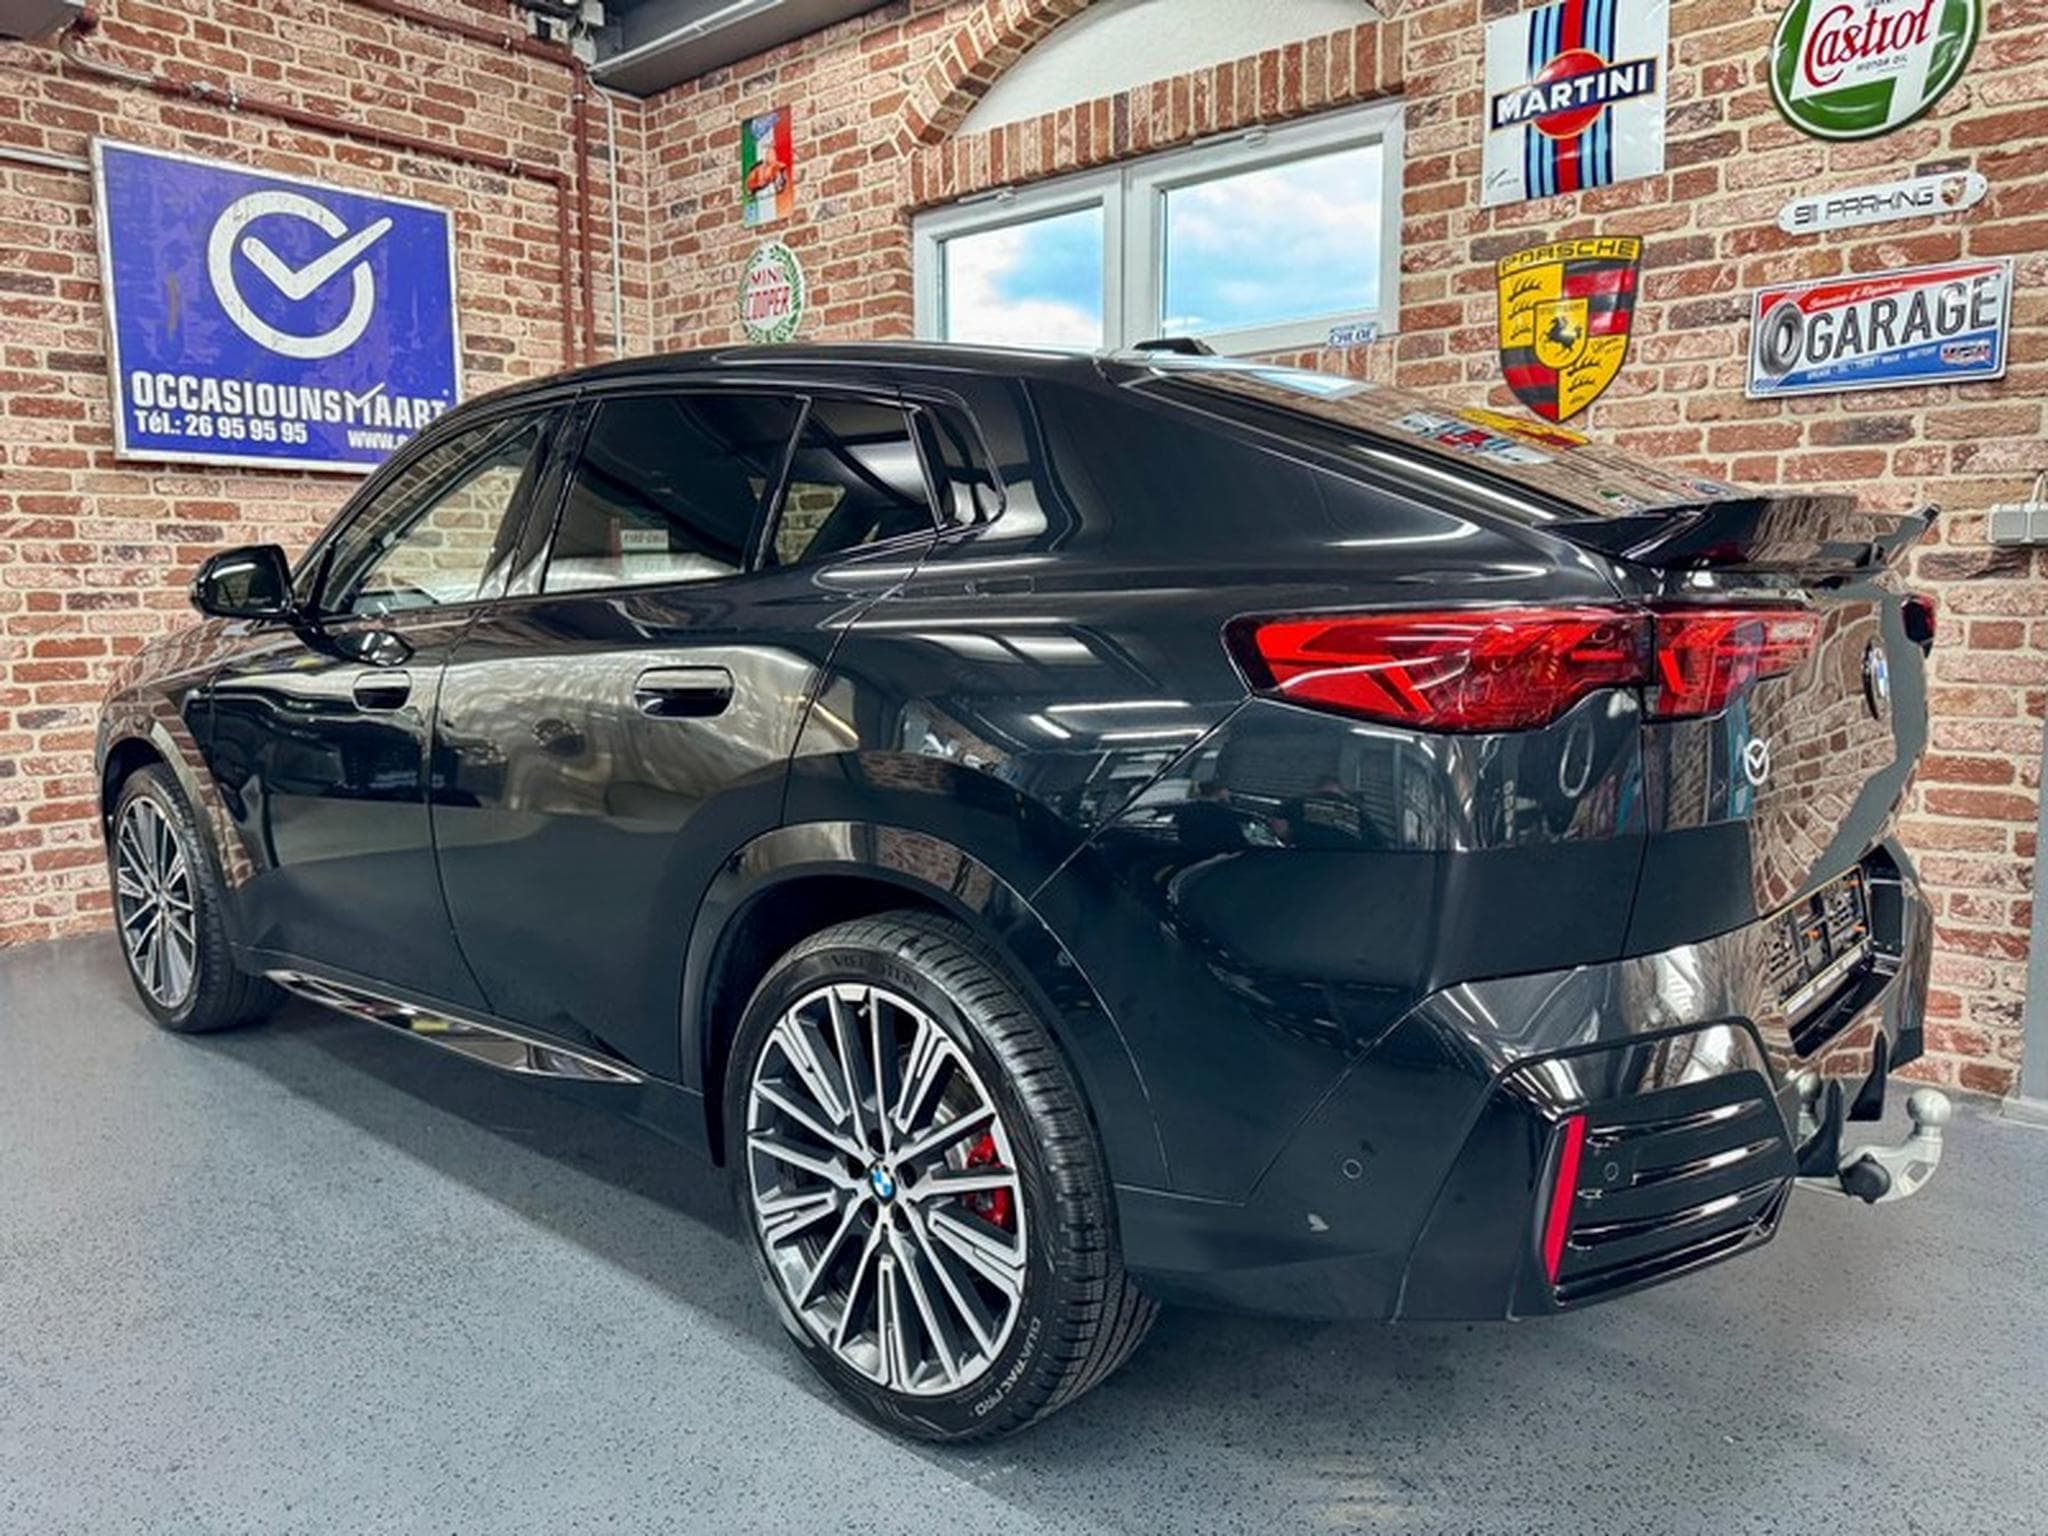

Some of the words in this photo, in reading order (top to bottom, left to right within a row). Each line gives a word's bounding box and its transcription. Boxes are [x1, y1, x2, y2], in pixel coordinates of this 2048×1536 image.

[1804, 0, 1936, 87] Castrol
[1497, 63, 1648, 123] MARTINI
[1825, 185, 1935, 220] PARKING
[1502, 240, 1635, 272] PORSCHE
[1805, 275, 2000, 365] GARAGE
[131, 370, 447, 430] OCCASIOUNSMAART
[134, 409, 182, 435] Tél.:
[186, 414, 212, 438] 26
[217, 417, 246, 440] 95
[249, 419, 279, 442] 95
[281, 421, 309, 445] 95
[1000, 1315, 1041, 1394] QUATRAC
[974, 1387, 1005, 1417] PRO
